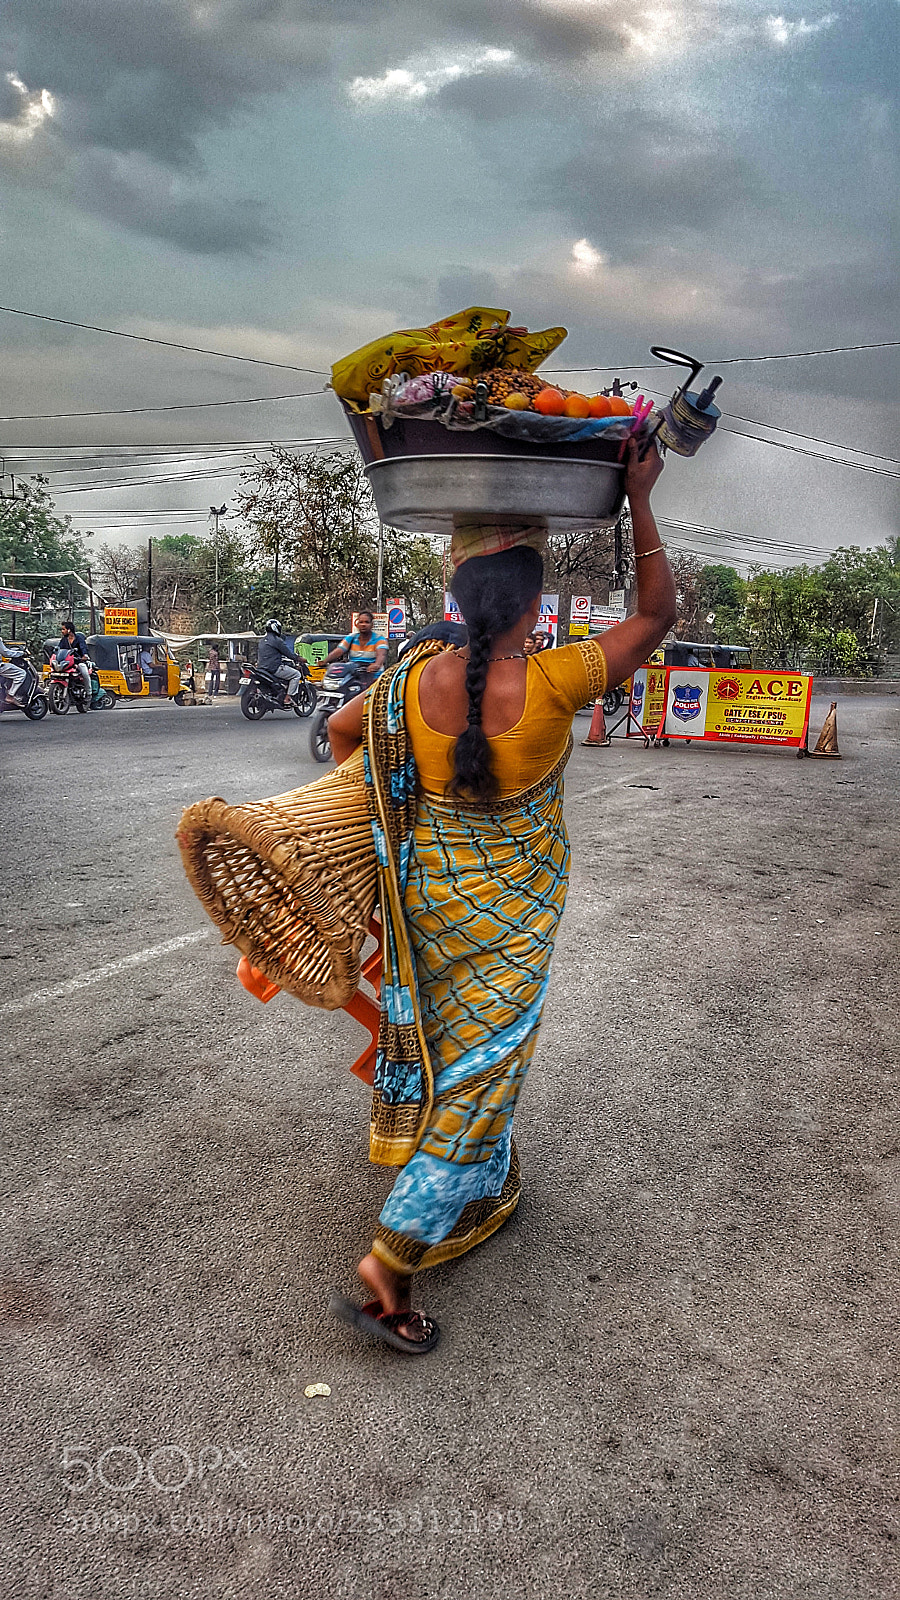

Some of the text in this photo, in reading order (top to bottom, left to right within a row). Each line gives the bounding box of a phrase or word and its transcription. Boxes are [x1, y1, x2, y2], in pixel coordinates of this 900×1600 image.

[746, 679, 803, 697] ACE
[674, 701, 699, 709] POLICE
[724, 709, 742, 717] GATE
[748, 710, 761, 718] ESE
[767, 711, 787, 720] PSUs
